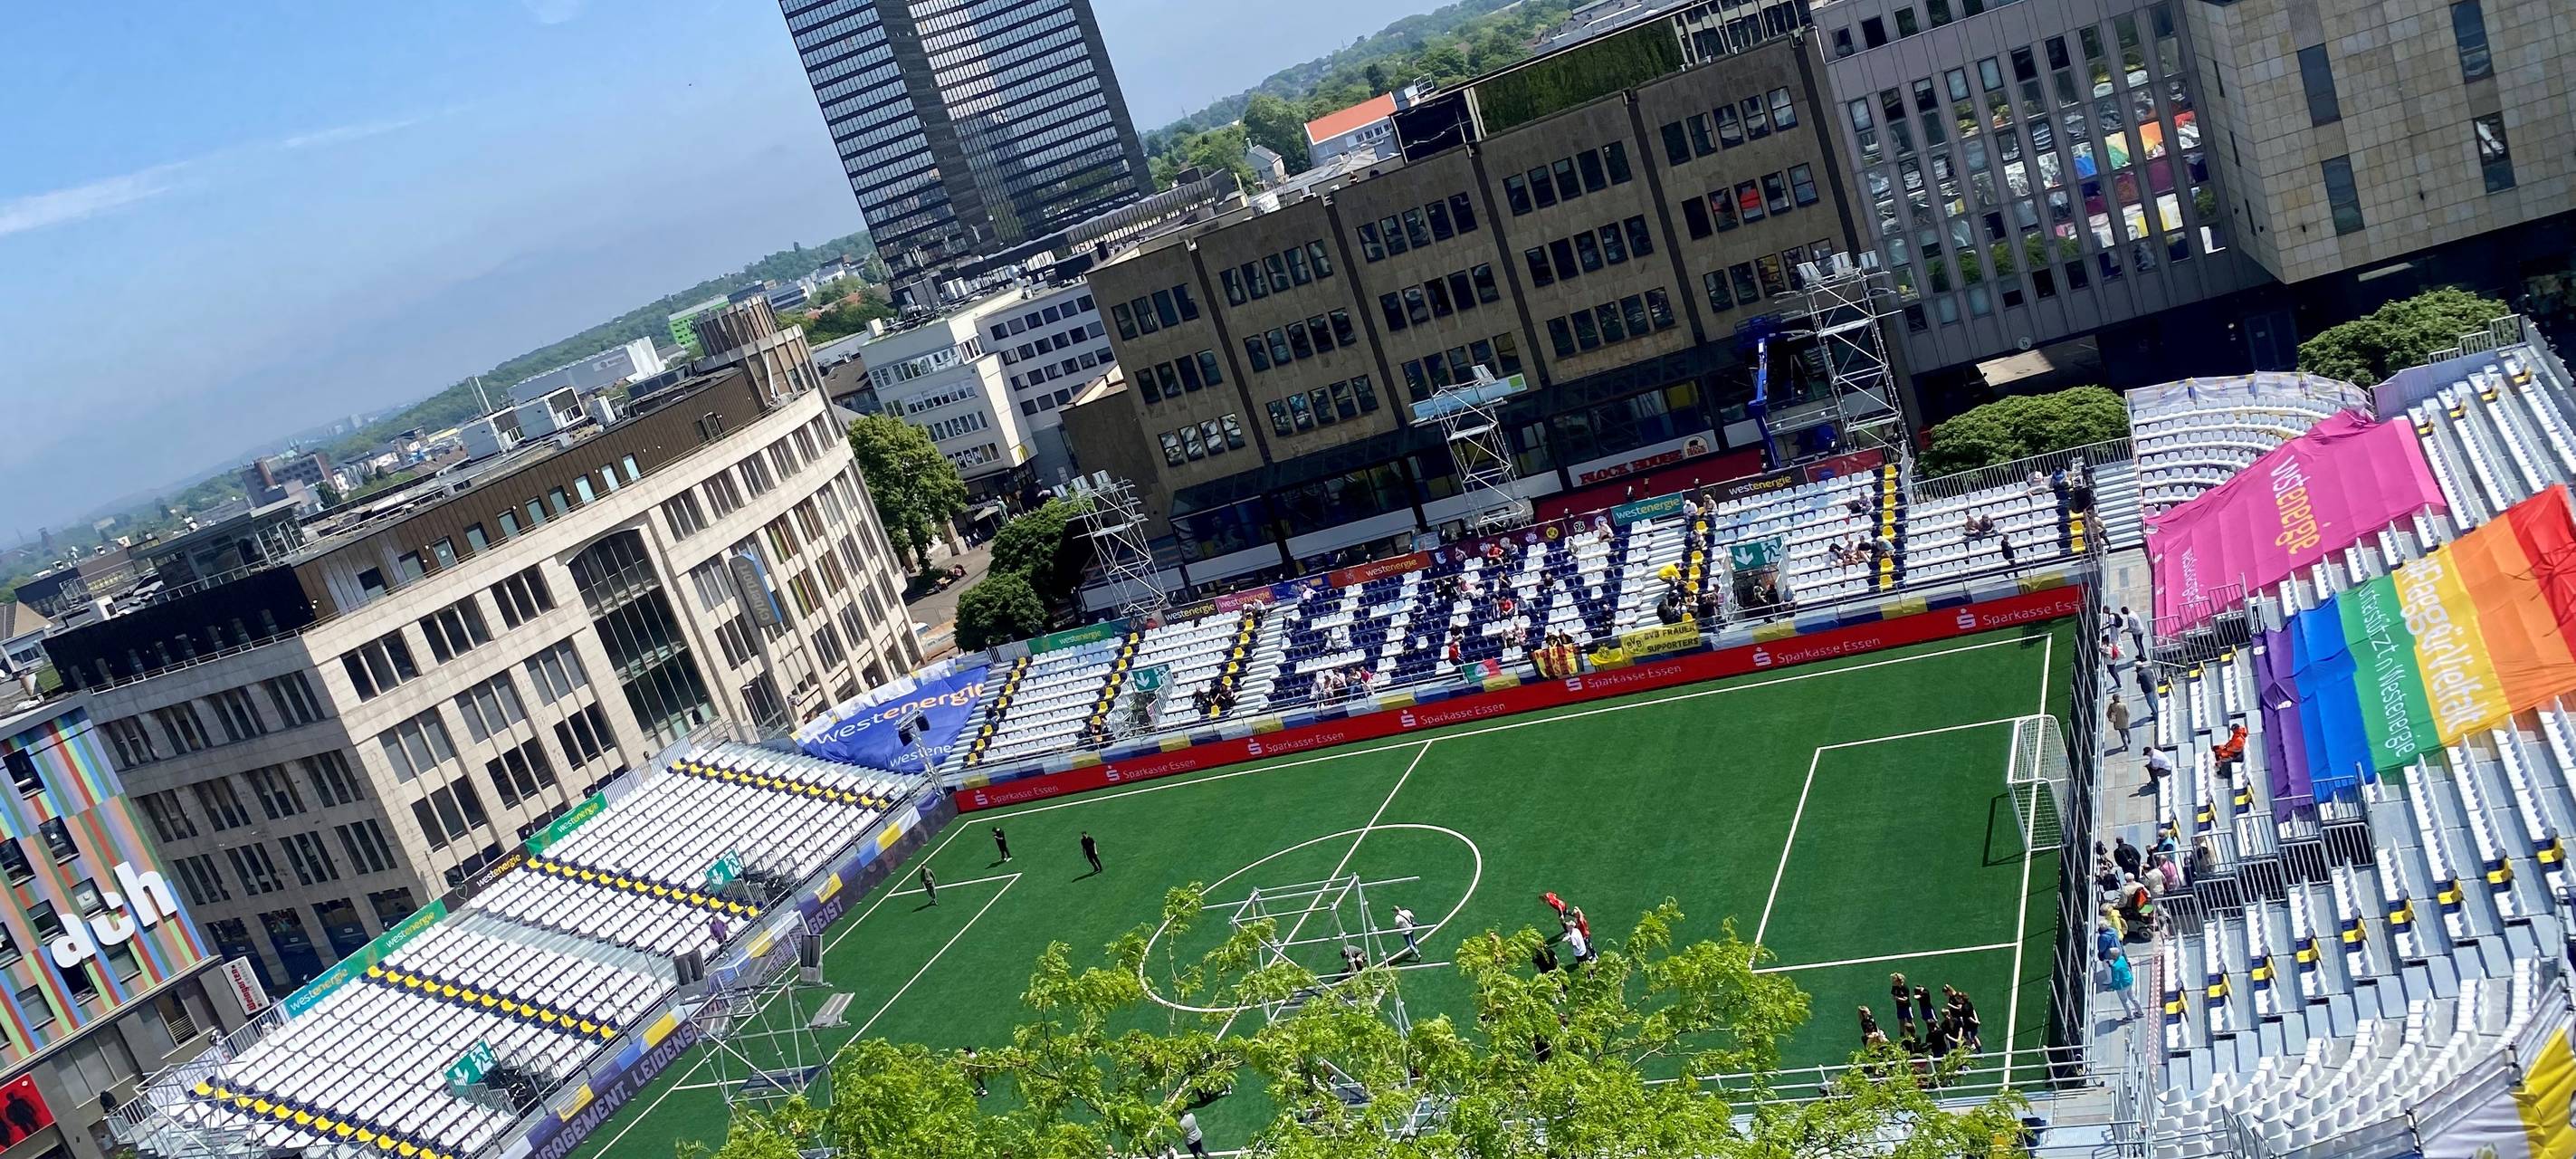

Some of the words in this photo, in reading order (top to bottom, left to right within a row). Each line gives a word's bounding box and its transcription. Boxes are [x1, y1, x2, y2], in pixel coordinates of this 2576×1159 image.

[1729, 474, 1792, 496] westenergie
[1616, 496, 1681, 521] westenergie
[1365, 557, 1417, 579] westenergie
[738, 563, 769, 621] cyberport
[1218, 589, 1272, 609] westenergie
[1164, 601, 1216, 623] westenergie
[1982, 606, 2053, 627] Sparkasse
[1058, 628, 1102, 646] westenergie
[1646, 637, 1699, 653] SUPPORTERS
[1777, 644, 1842, 666] Sparkasse
[1843, 636, 1882, 653] Essen
[1587, 669, 1646, 689] Sparkasse
[1646, 664, 1683, 679] Essen
[1419, 707, 1473, 726] Sparkasse
[1474, 701, 1506, 715] Essen
[1265, 735, 1314, 754] Sparkasse
[1314, 731, 1345, 745] Essen
[1122, 762, 1169, 781] Sparkasse
[1169, 757, 1197, 771] Essen
[990, 788, 1033, 804] Sparkasse
[1033, 784, 1060, 797] Essen
[557, 800, 599, 834] westenergie
[476, 852, 522, 888] westenergie
[385, 910, 435, 949] westenergie
[290, 966, 348, 1011] westenergie
